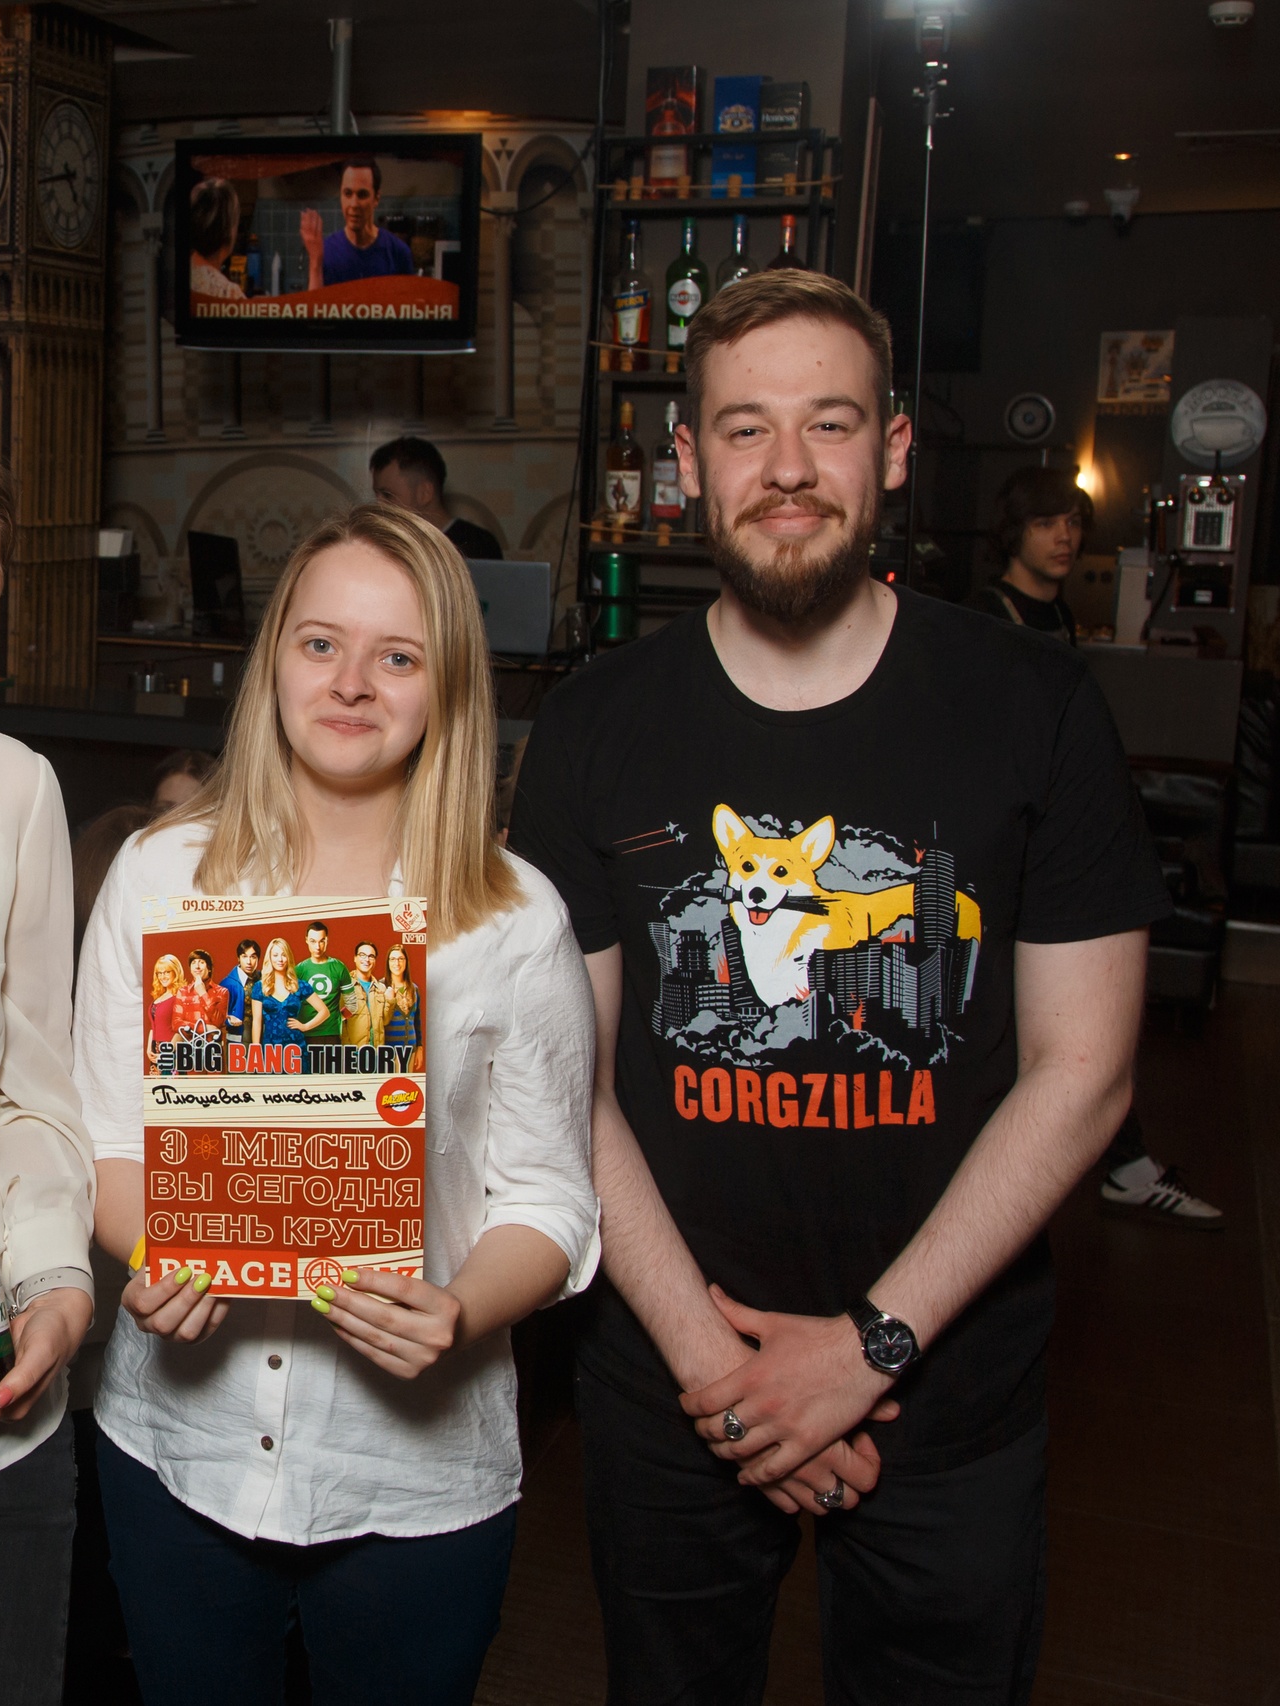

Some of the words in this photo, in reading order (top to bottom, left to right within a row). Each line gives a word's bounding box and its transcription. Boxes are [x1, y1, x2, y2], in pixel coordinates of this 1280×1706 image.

[196, 303, 308, 319] ПЛЮШЕВАЯ
[314, 304, 453, 319] НАКОВАЛЬНЯ
[182, 899, 245, 912] 09.05.2023
[157, 1042, 174, 1071] the
[228, 1043, 303, 1074] BANG
[307, 1044, 414, 1074] THEORY
[152, 1085, 255, 1107] Плюшевая
[263, 1088, 367, 1105] наковальня
[674, 1065, 936, 1130] CORGZILLA
[222, 1130, 411, 1171] МЕСТО
[150, 1171, 213, 1202] ВЫ
[227, 1173, 421, 1212] СЕГОДНЯ
[147, 1211, 274, 1244] ОЧЕНЬ
[283, 1216, 422, 1248] КРУТЫ!
